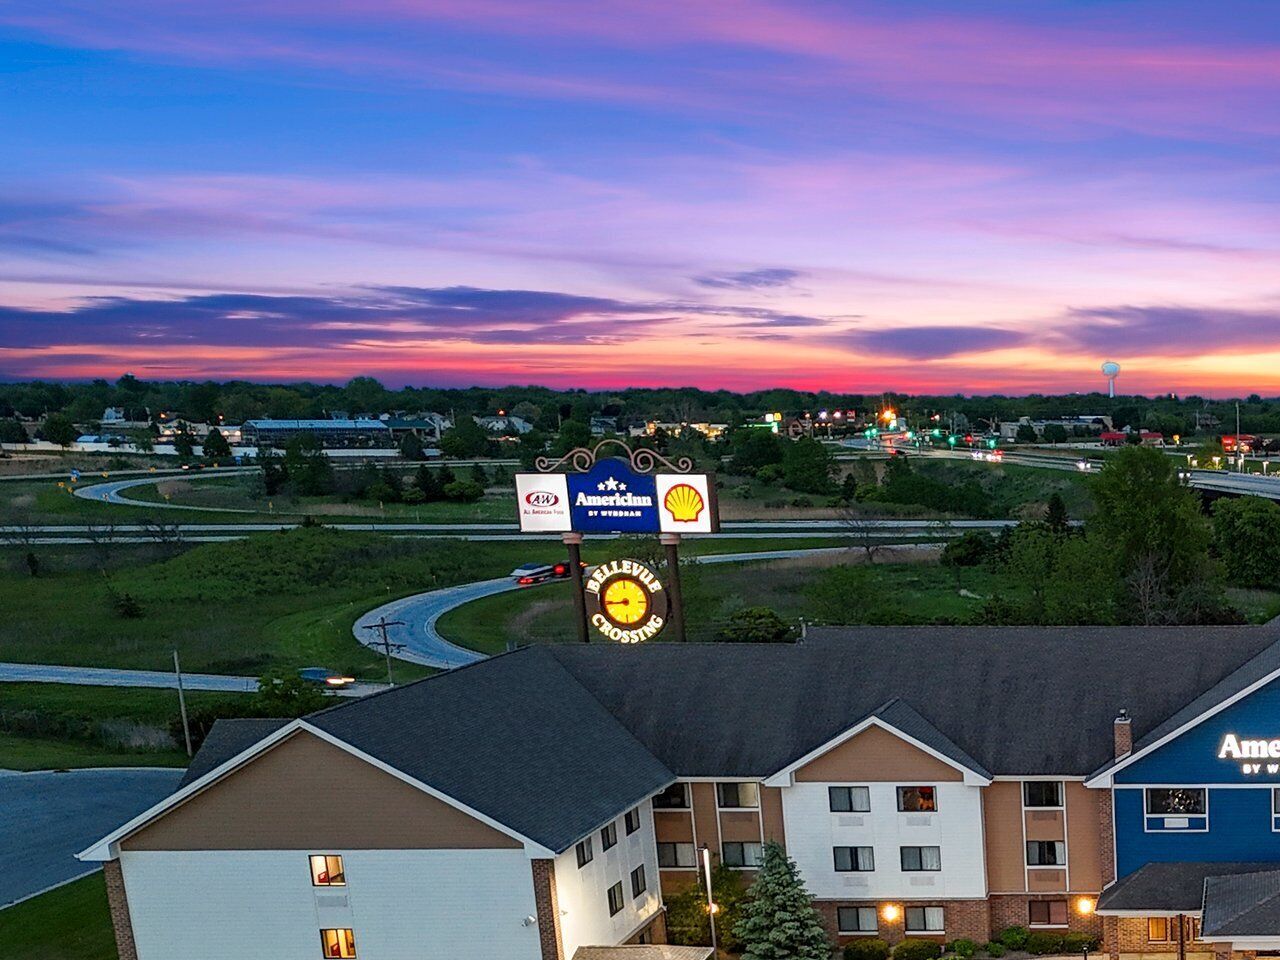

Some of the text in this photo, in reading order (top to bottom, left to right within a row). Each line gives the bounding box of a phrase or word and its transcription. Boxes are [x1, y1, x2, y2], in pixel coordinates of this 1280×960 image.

[575, 492, 653, 507] AmericInn
[586, 559, 662, 594] BELLEVUE
[591, 612, 664, 644] CROSSING
[1243, 763, 1261, 775] BY
